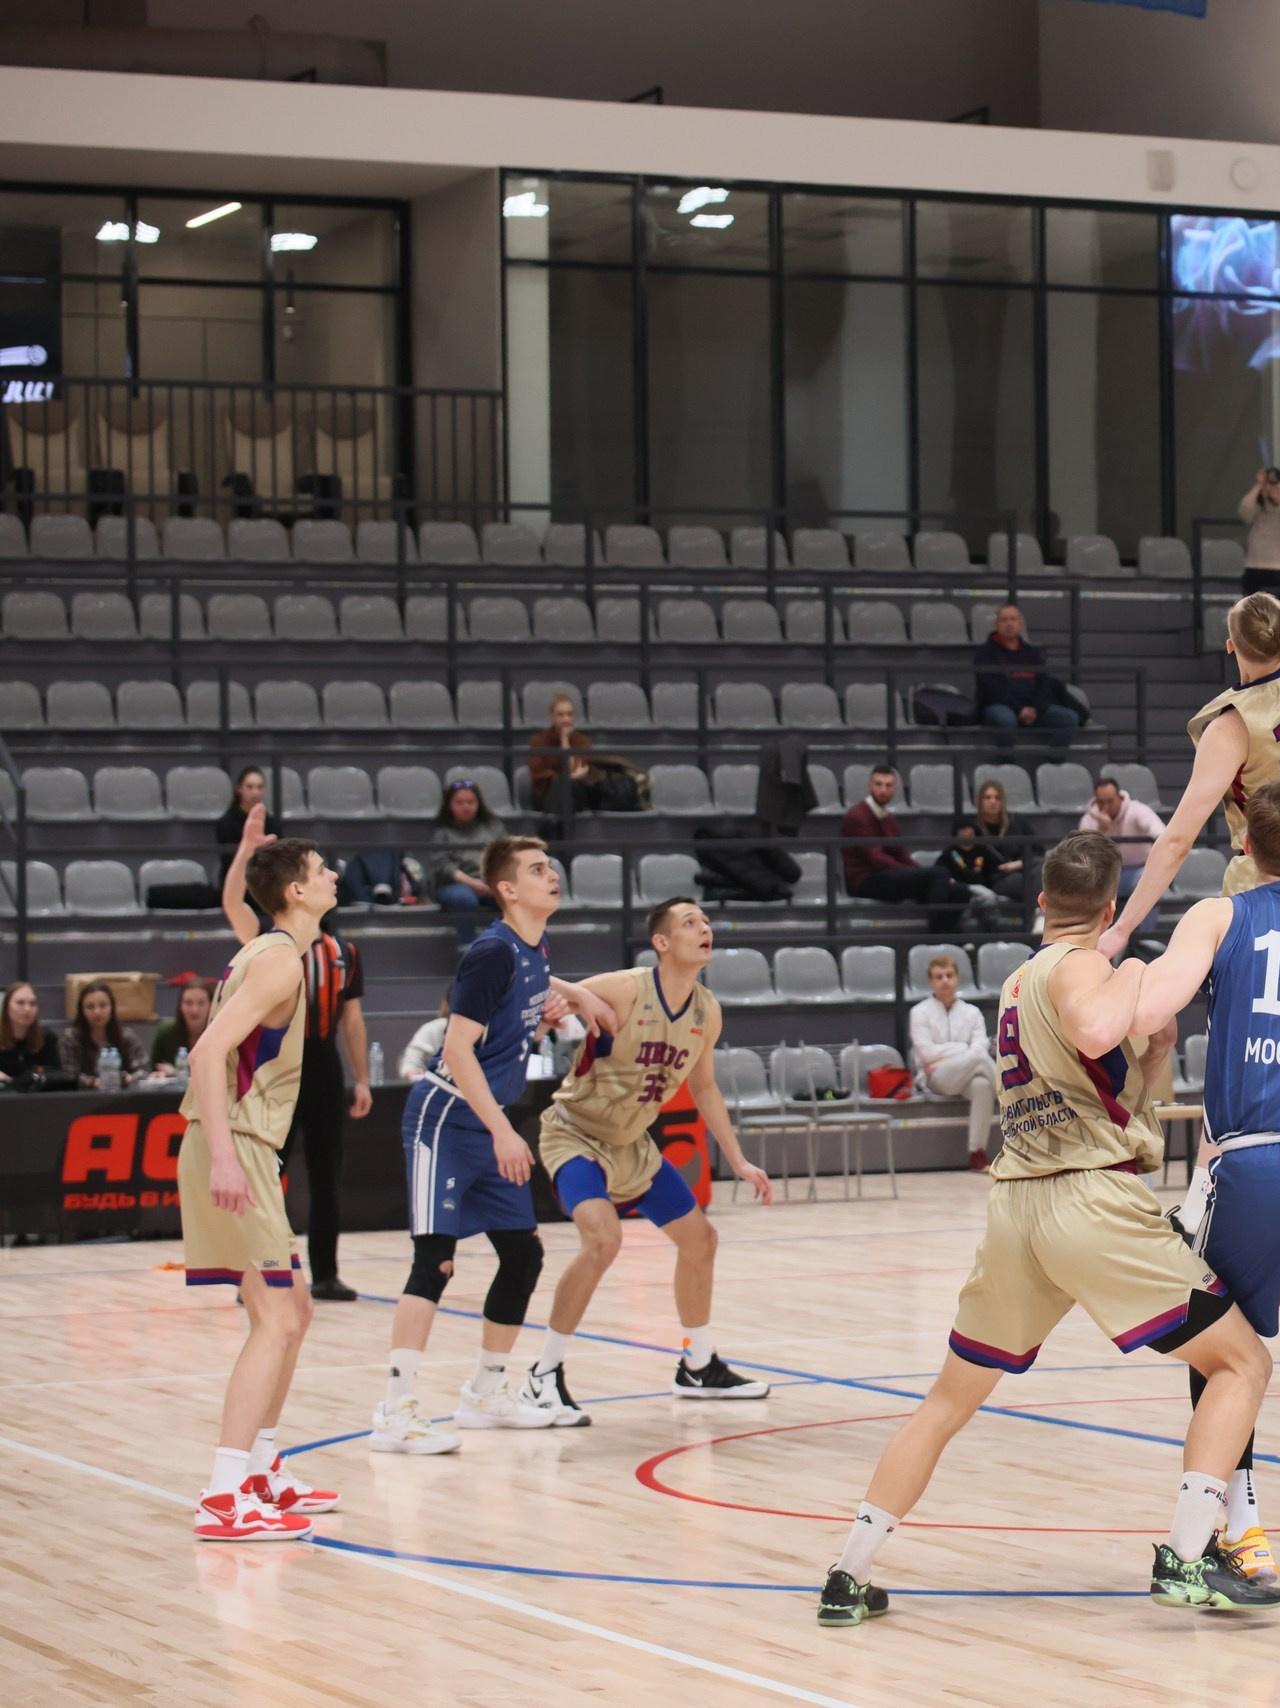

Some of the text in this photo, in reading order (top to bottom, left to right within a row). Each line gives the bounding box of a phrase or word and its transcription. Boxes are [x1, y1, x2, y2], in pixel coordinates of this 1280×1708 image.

[999, 1006, 1033, 1091] 9
[63, 1193, 136, 1210] БУДЬ
[139, 1191, 159, 1207] В
